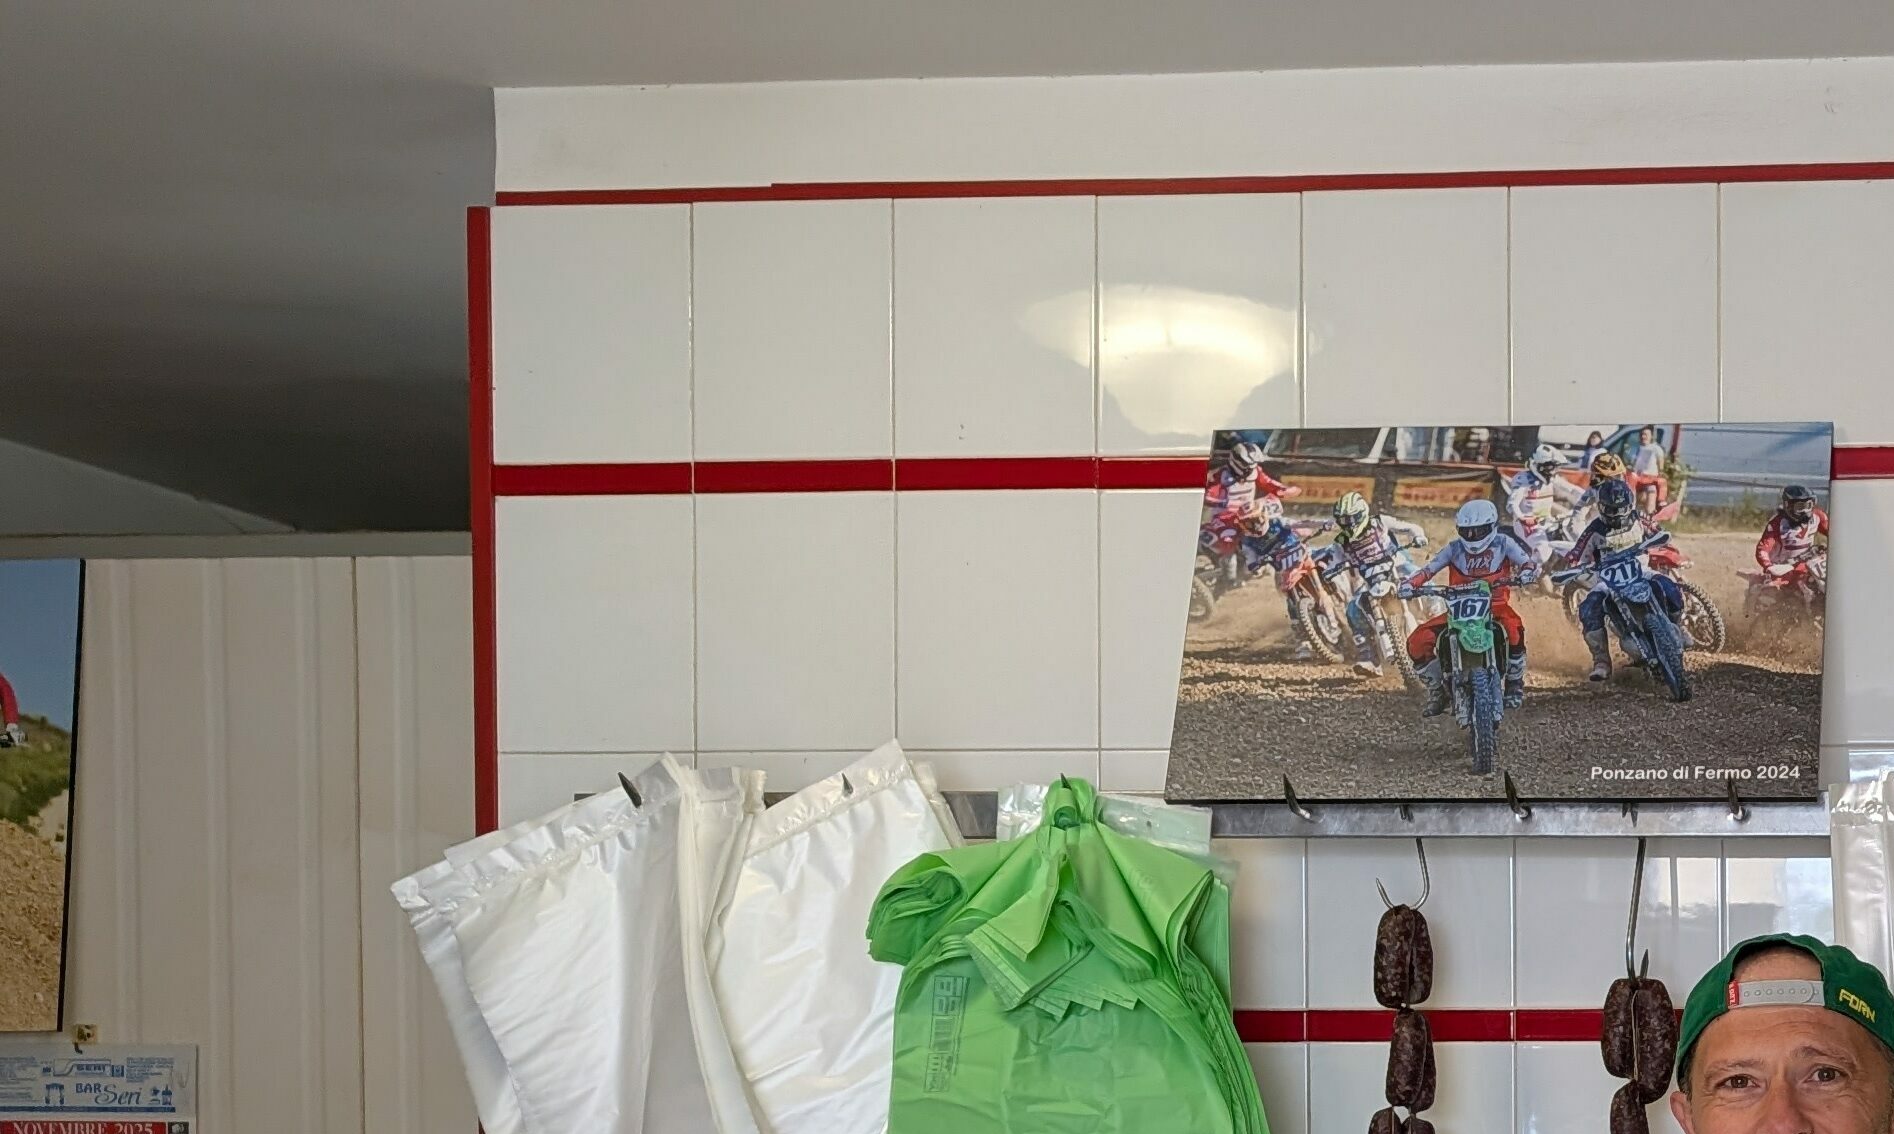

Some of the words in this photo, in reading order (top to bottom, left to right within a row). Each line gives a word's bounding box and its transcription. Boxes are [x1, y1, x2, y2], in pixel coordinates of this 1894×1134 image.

[1605, 560, 1639, 584] 217
[1450, 598, 1487, 620] 167
[1590, 766, 1667, 782] Ponzano
[1672, 765, 1689, 780] di
[1694, 766, 1751, 780] Fermo
[1756, 765, 1800, 780] 2024
[76, 1083, 101, 1093] BAR
[95, 1084, 142, 1105] Seri
